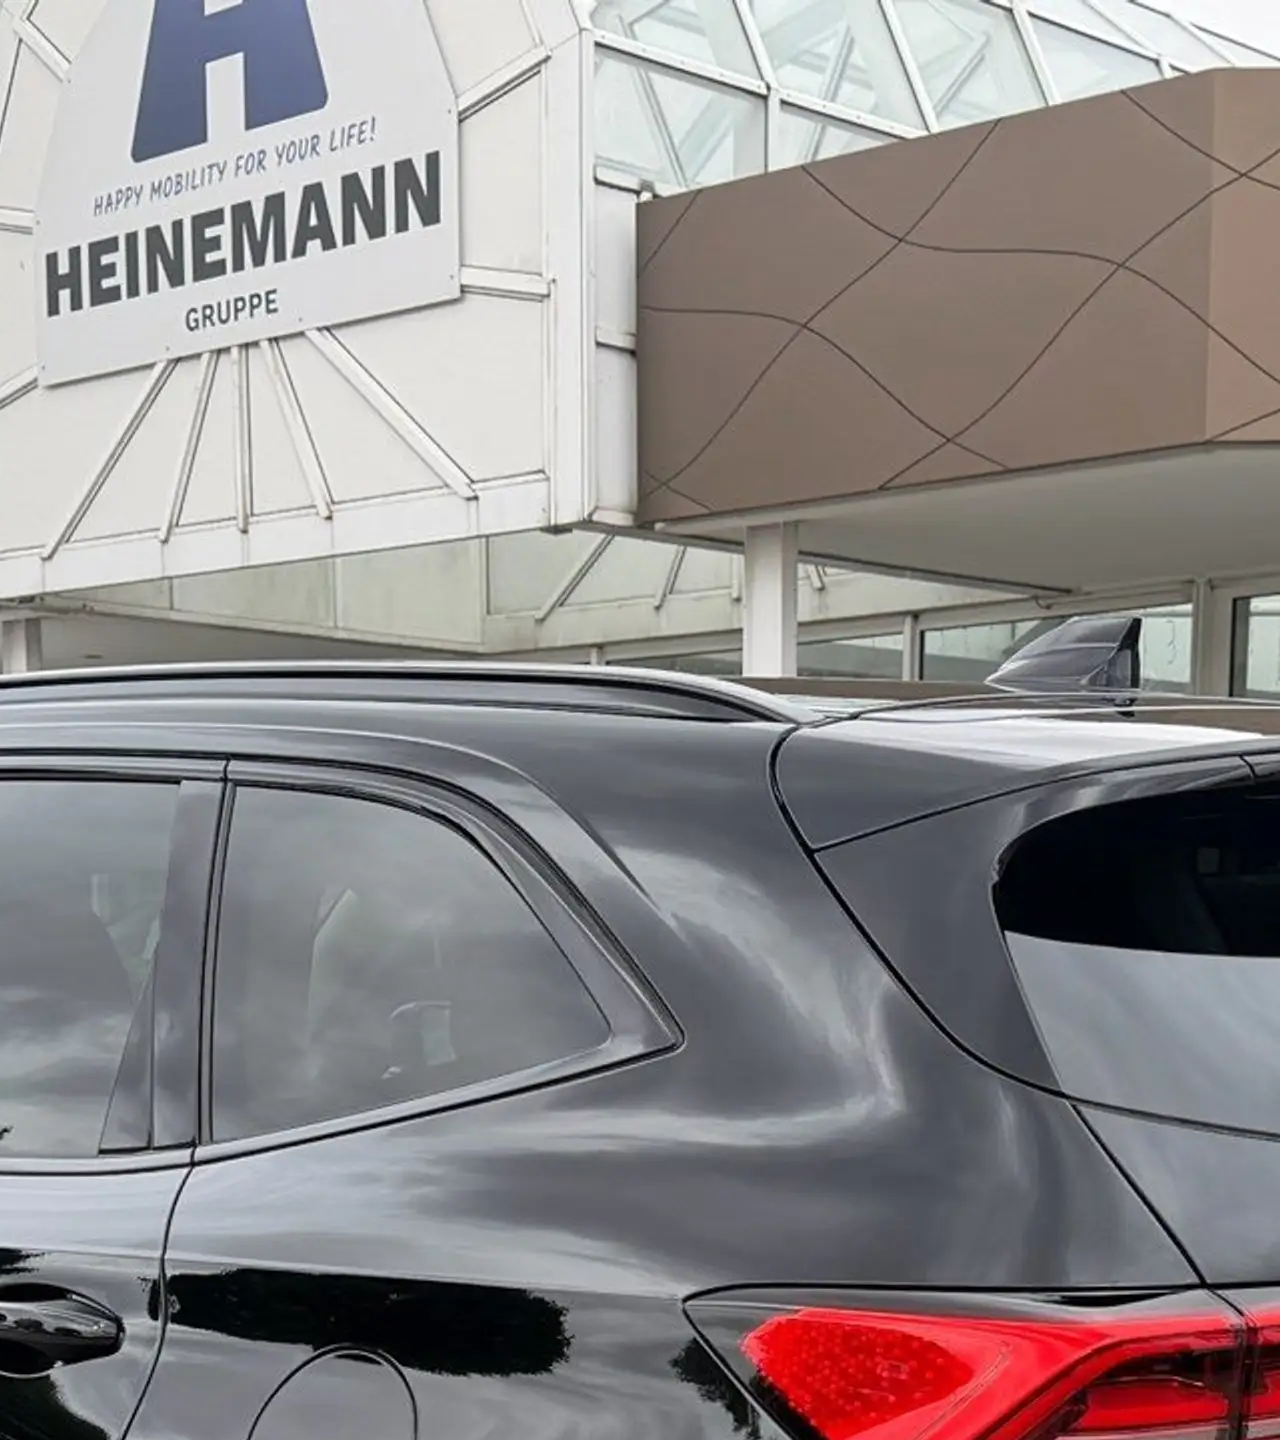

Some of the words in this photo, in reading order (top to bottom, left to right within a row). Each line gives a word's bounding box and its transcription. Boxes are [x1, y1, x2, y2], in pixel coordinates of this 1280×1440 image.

[93, 184, 144, 217] HAPPY
[149, 160, 228, 203] MOBILITY
[235, 149, 268, 176] FOR
[274, 132, 322, 166] YOUR
[329, 115, 377, 152] LIFE!
[45, 150, 442, 318] HEINEMANN
[185, 288, 279, 332] GRUPPE
